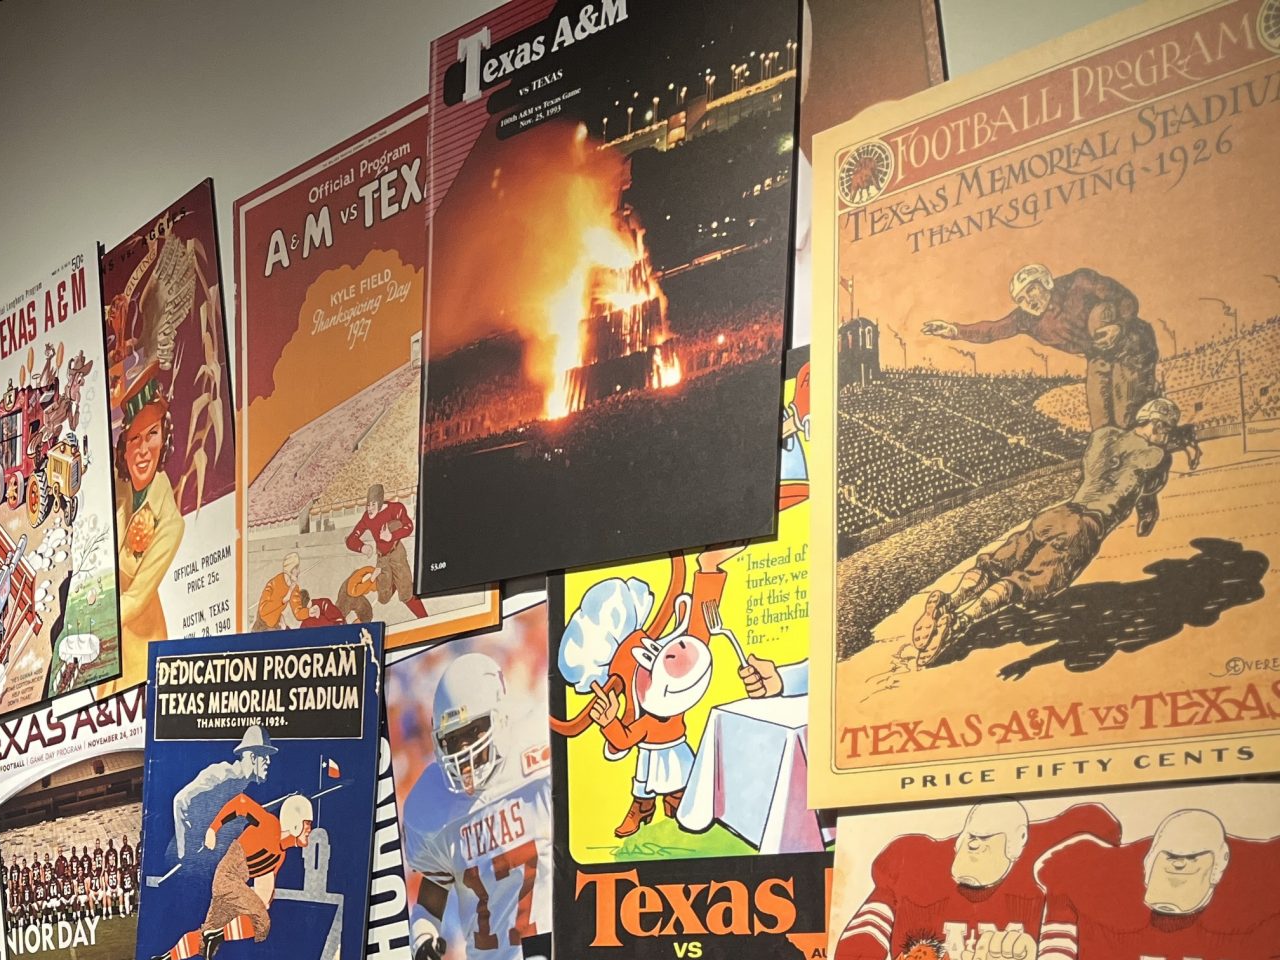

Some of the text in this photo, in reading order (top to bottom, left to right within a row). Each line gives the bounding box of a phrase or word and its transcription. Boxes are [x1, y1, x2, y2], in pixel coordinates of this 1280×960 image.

[457, 0, 628, 104] Texas A&M
[531, 69, 563, 92] TEXAS
[890, 12, 1257, 184] FOOTBALL PROGRAM
[520, 118, 534, 128] Nov.
[546, 106, 561, 117] 1993
[309, 168, 354, 203] Official
[360, 142, 411, 178] Program
[844, 184, 950, 243] TEXAS
[954, 127, 1121, 209] MEMORIAL
[907, 124, 1233, 254] THANKSGIVING 1926
[330, 269, 391, 307] KYLE FIELD
[312, 280, 411, 335] Thanksgiving Day
[348, 319, 371, 350] 1927
[174, 545, 231, 582] OFFICIAL PROGRAM
[430, 560, 446, 571] $3.00
[209, 600, 230, 618] TEXAS
[762, 602, 809, 624] thankful
[159, 648, 357, 685] DEDICATION PROGRAM
[159, 686, 359, 715] TEXAS MEMORIAL STADIUM
[87, 727, 143, 748] NOVEMBER 2011
[840, 702, 1086, 759] TEXAS A&M
[900, 746, 1256, 789] PRICE FIFTY CENTS
[460, 802, 525, 861] TEXAS
[575, 869, 797, 948] Texas
[58, 916, 100, 949] DAY
